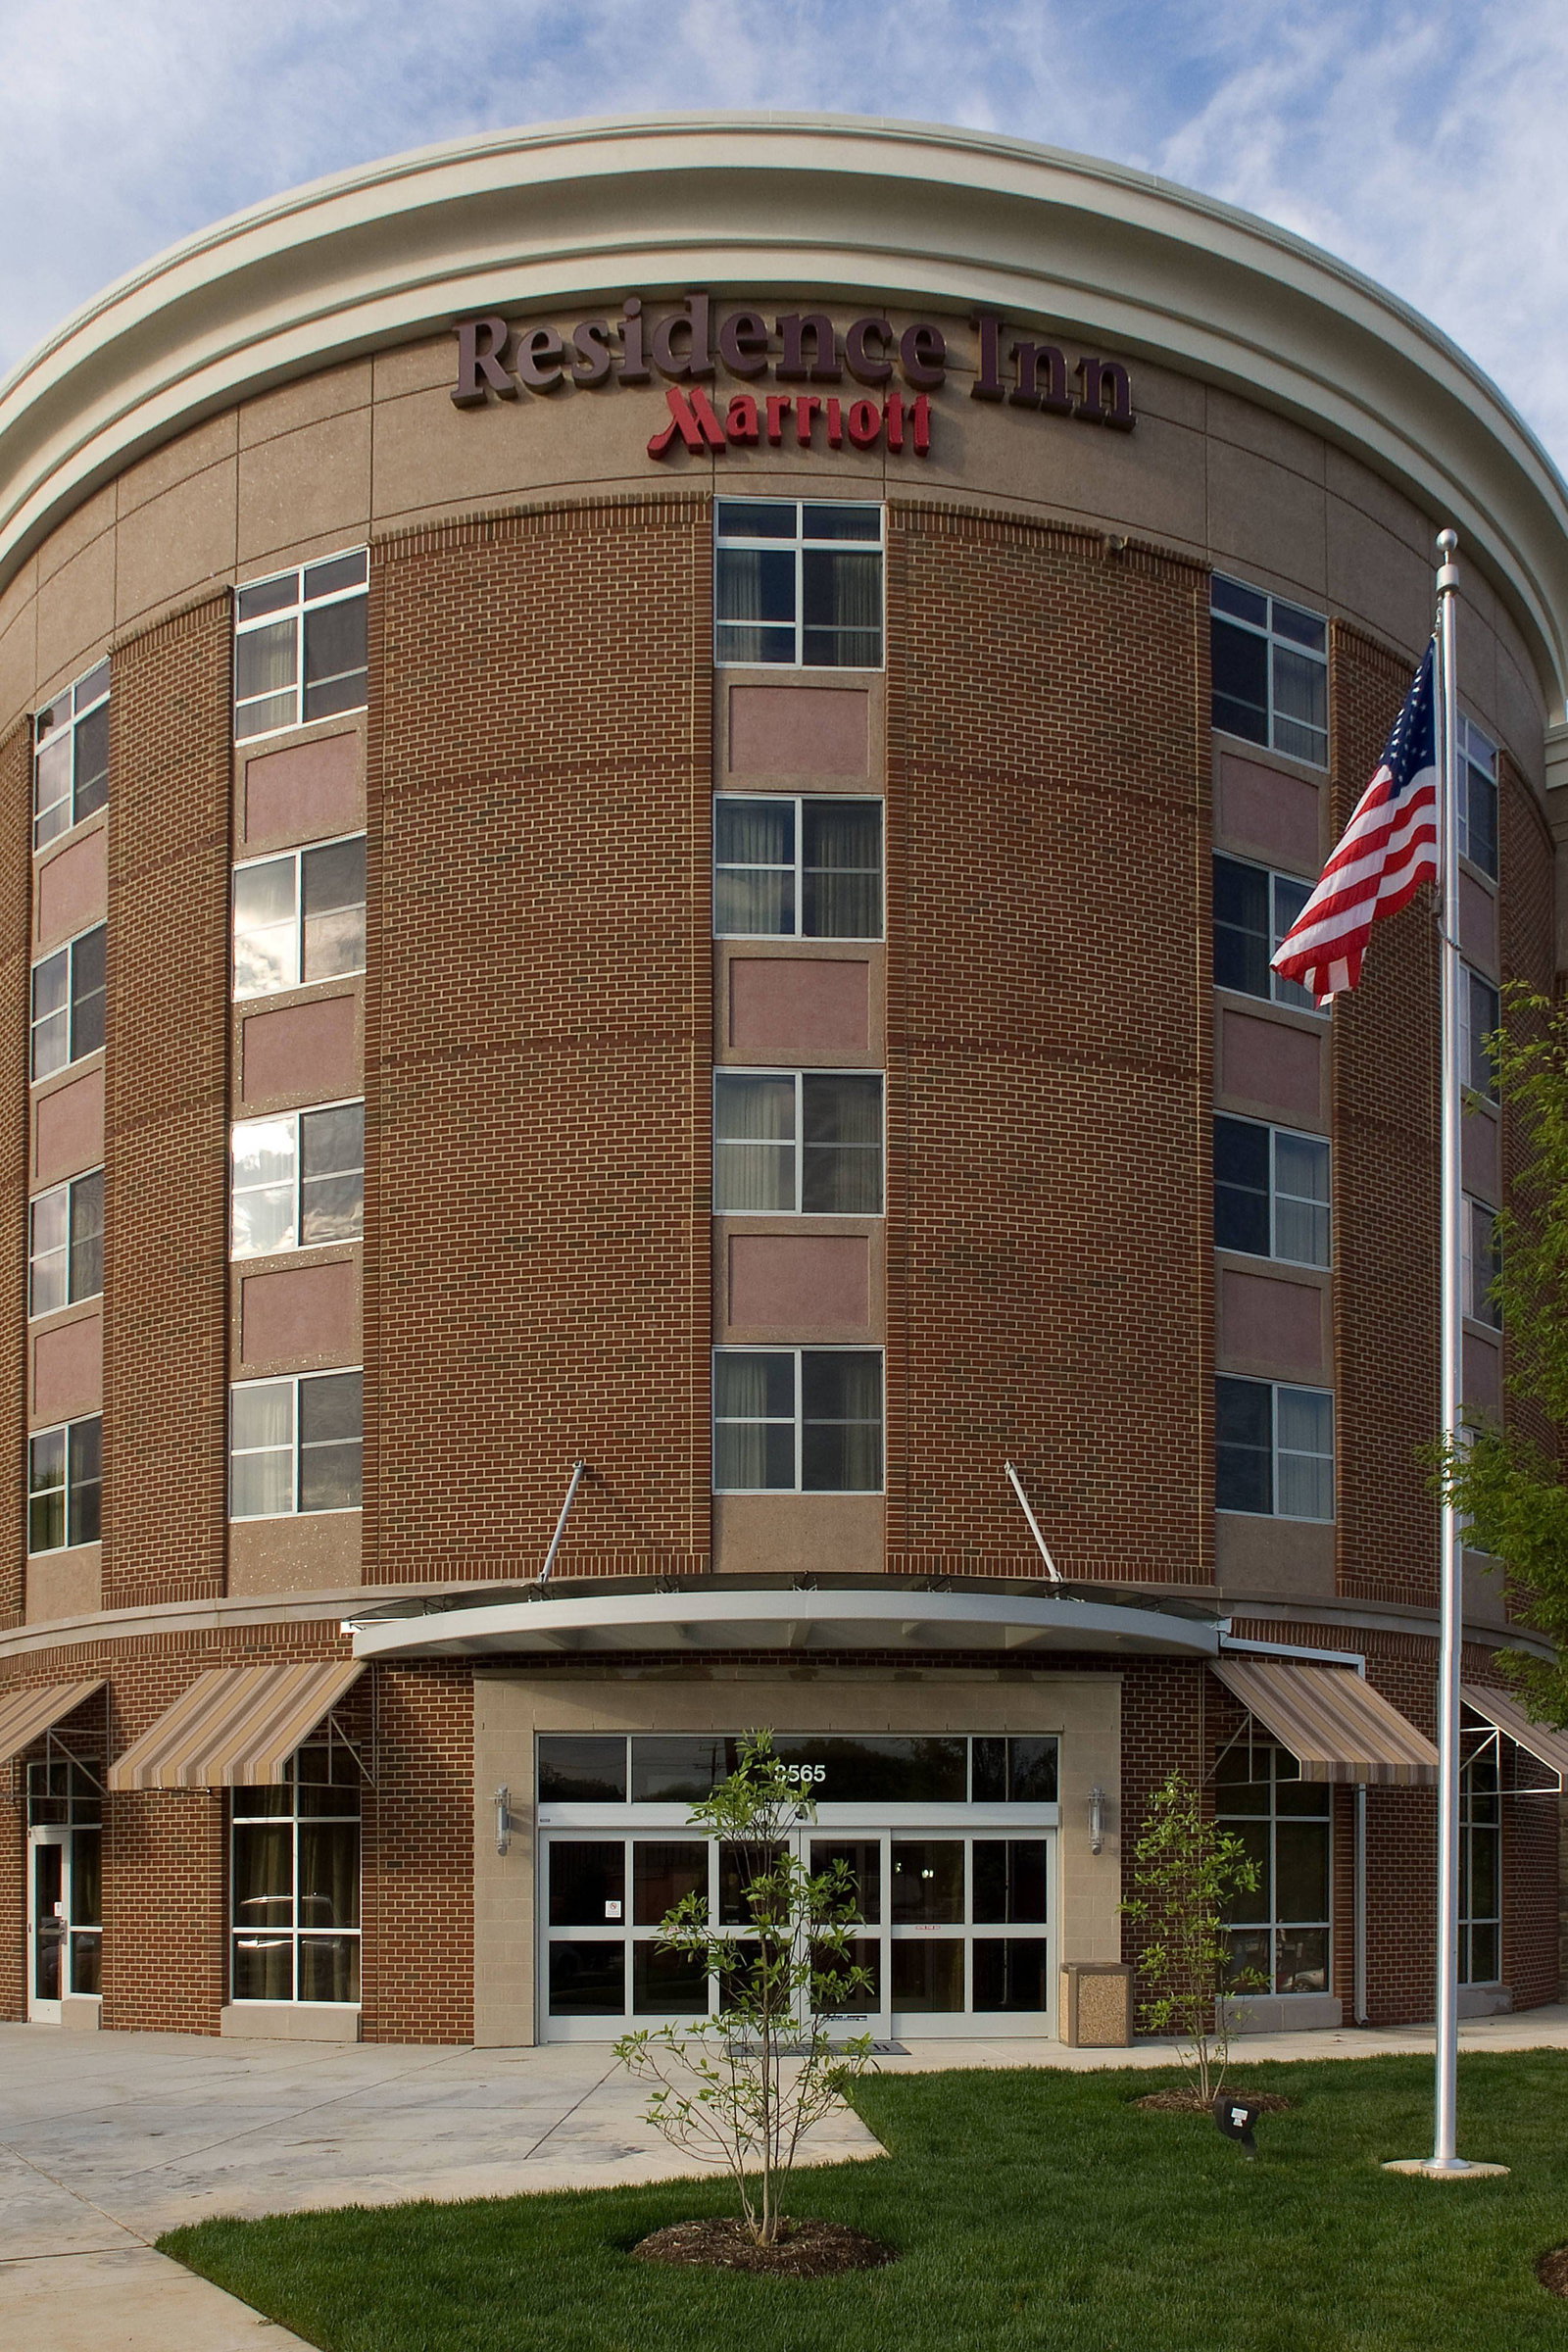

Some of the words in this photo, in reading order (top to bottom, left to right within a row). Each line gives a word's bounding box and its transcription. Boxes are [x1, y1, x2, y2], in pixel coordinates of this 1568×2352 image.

[450, 293, 947, 409] Residence
[969, 310, 1137, 432] Inn
[647, 386, 931, 460] Marriott
